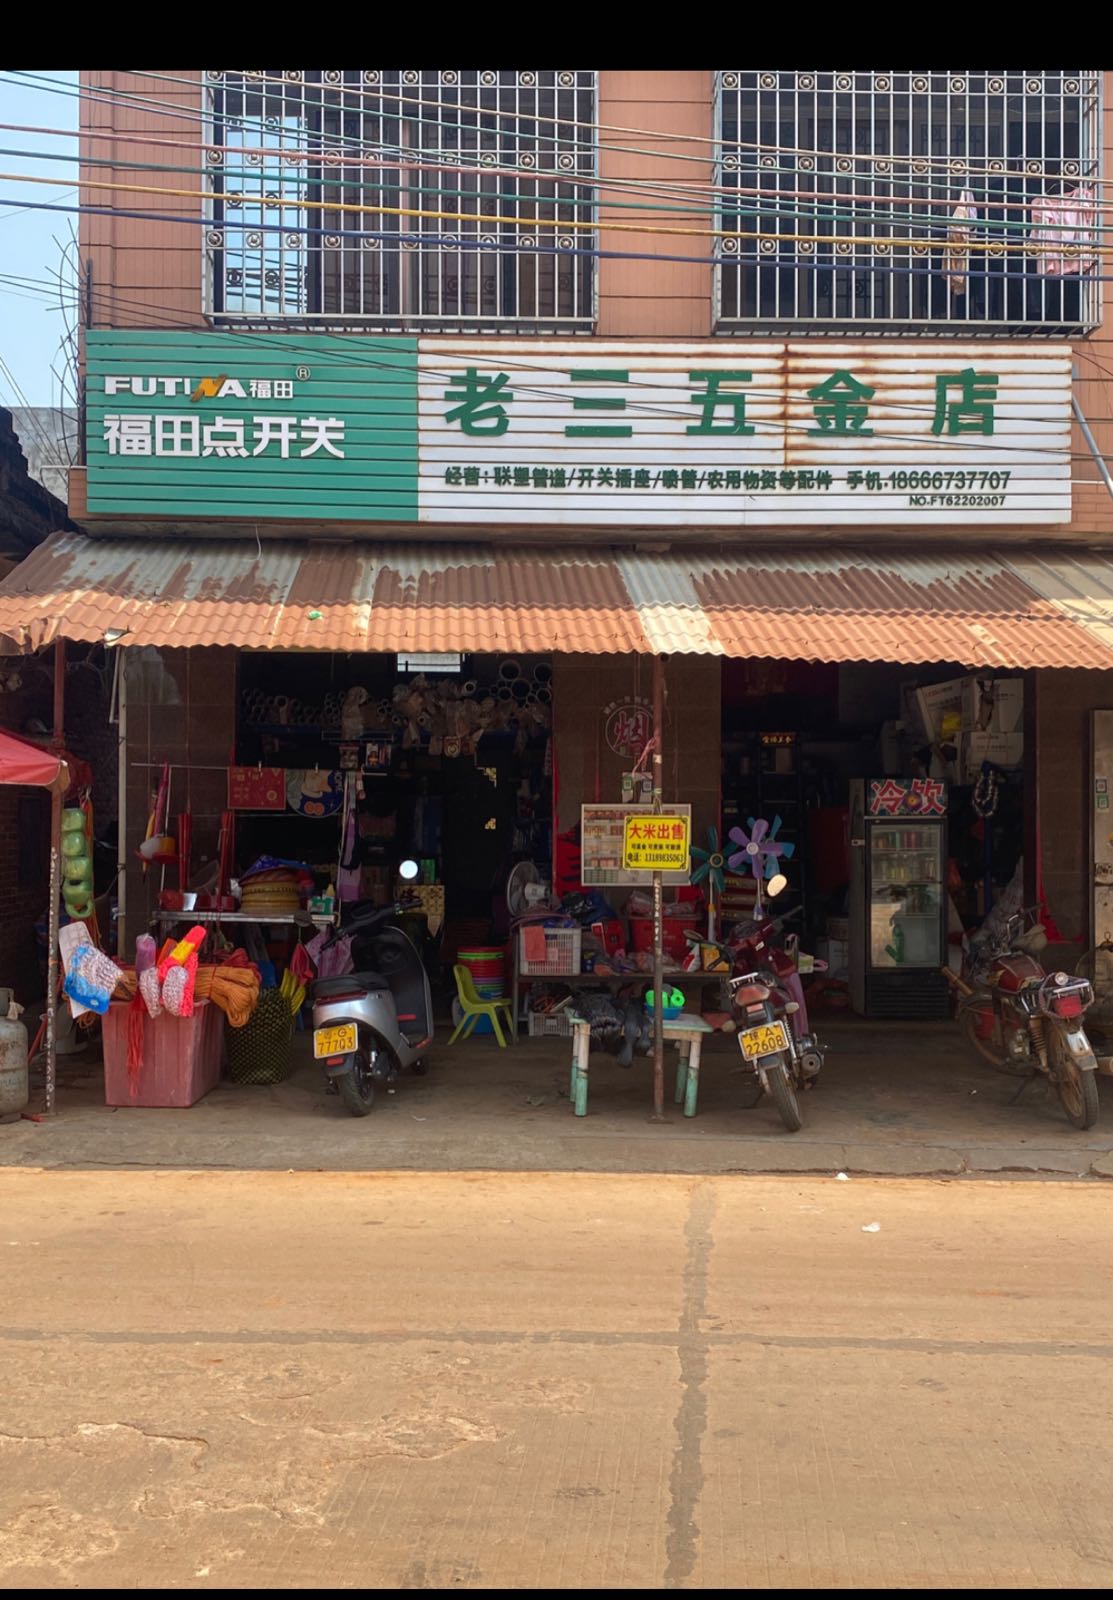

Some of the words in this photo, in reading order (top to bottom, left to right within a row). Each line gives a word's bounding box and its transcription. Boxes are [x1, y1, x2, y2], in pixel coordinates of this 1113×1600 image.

[104, 374, 247, 402] FUTINA
[249, 379, 294, 399] 福田
[444, 367, 999, 438] 老三五金店
[103, 414, 346, 459] 福田点开关
[870, 778, 948, 815] 冷饮
[629, 823, 684, 840] 大米出售
[746, 1035, 784, 1056] 22608
